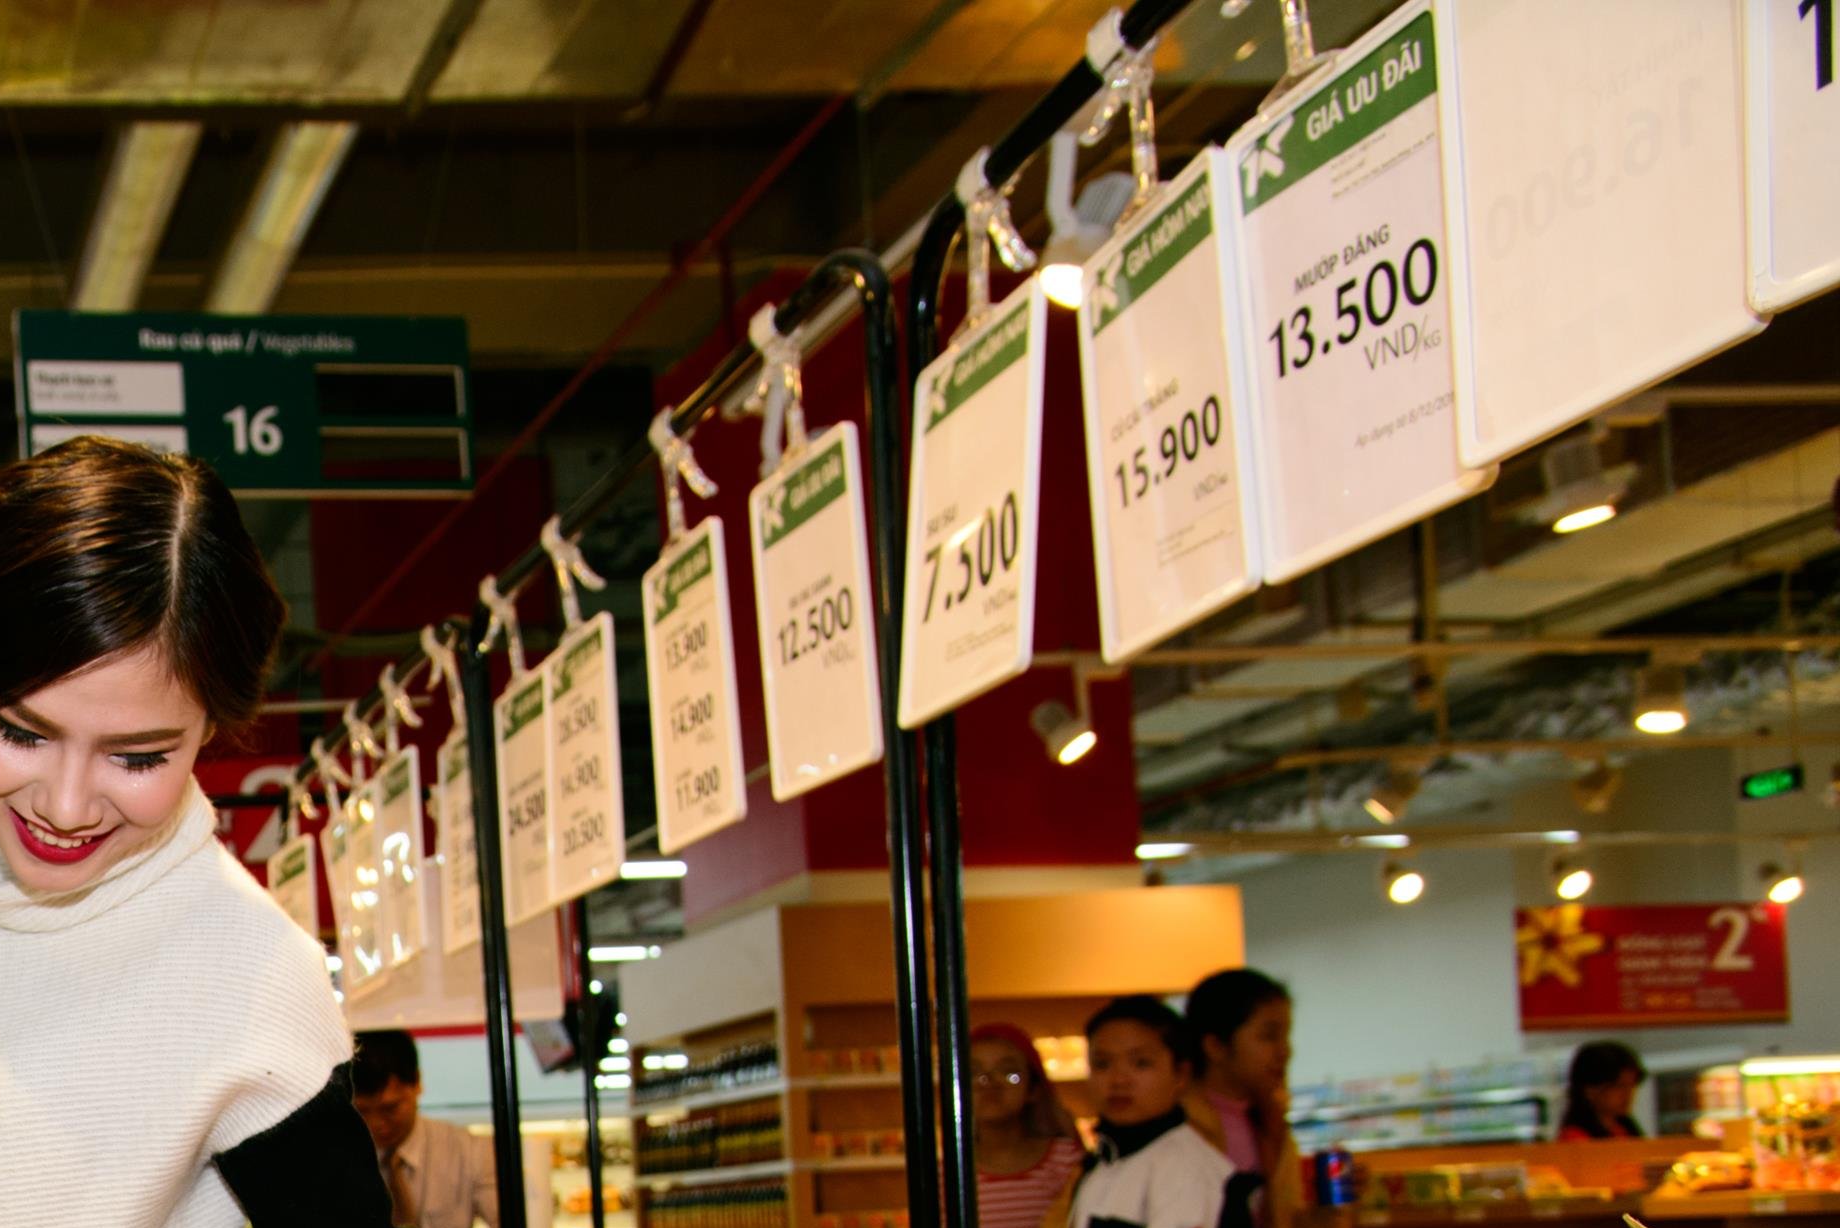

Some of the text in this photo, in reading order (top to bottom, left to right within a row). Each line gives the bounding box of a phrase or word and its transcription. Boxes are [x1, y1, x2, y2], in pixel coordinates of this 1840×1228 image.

[1306, 40, 1421, 141] GIÁ ƯU ĐÃI
[138, 328, 177, 349] Rau
[261, 329, 354, 355] Vegetables
[1268, 238, 1438, 378] 13.500
[223, 405, 283, 455] 16
[1116, 395, 1220, 508] 15.900
[923, 491, 1018, 624] 7.500
[777, 587, 853, 667] 12.500
[1709, 908, 1754, 970] 2
